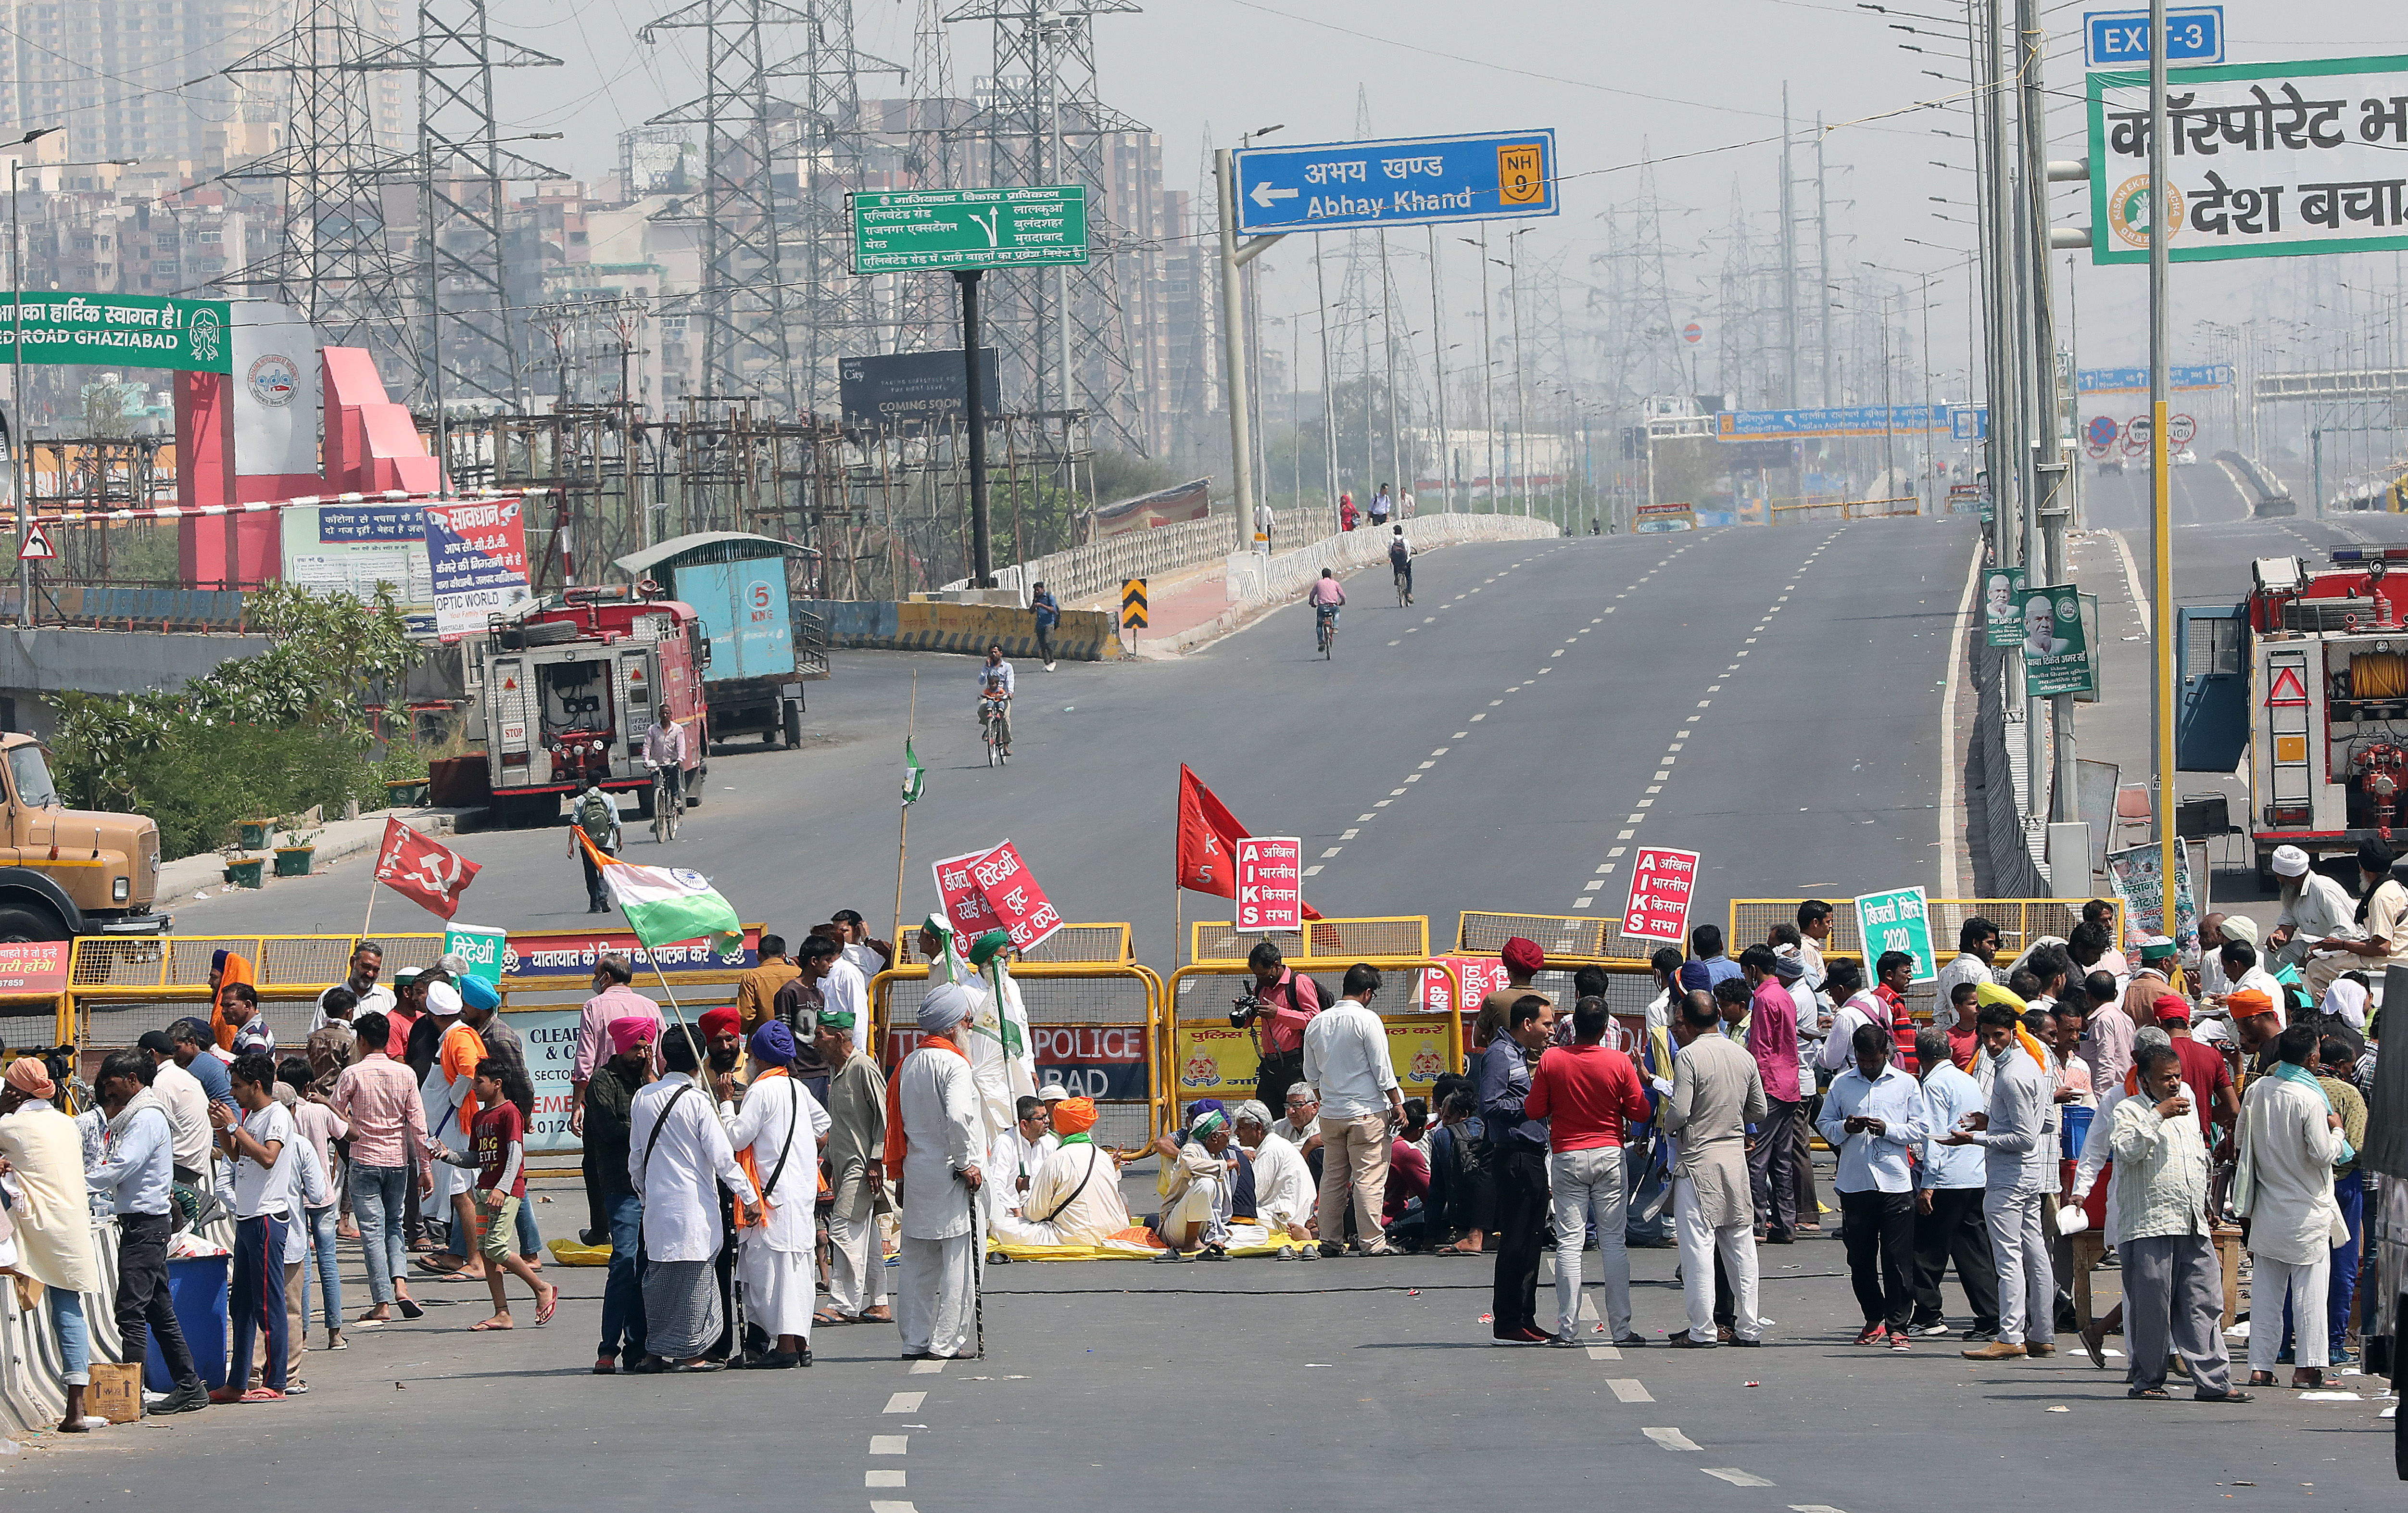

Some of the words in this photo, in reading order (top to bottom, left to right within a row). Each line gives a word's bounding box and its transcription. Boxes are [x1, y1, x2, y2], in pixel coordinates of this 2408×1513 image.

[1304, 160, 1367, 185] अभय
[1381, 155, 1443, 179] खण्ड
[1507, 155, 1532, 170] NH
[1515, 174, 1527, 194] 9
[962, 191, 1001, 202] विकास
[1007, 190, 1059, 201] प्राधिकरण
[1307, 195, 1384, 218] Abhay
[1394, 186, 1472, 213] Khand
[2113, 189, 2127, 220] KISAN
[2188, 169, 2284, 235] देश
[863, 208, 911, 223] एलिवेटेड
[913, 206, 932, 218] रोड
[1013, 216, 1064, 231] बुलंदशहर
[863, 223, 904, 236] राजनगर
[864, 239, 888, 250] मेरठ
[1014, 232, 1064, 246] मुरादाबाद
[910, 252, 927, 264] रोड
[929, 252, 938, 264] में
[943, 251, 962, 264] भारी
[998, 250, 1012, 261] का
[49, 296, 101, 323] हार्दिक
[104, 305, 158, 326] स्वागत
[22, 330, 70, 344] ROAD
[74, 330, 178, 350] GHAZIABAD
[844, 369, 865, 382] City
[878, 399, 927, 413] COMING
[929, 398, 962, 410] SOON
[448, 504, 500, 531] सावधान
[444, 543, 461, 555] आप
[457, 556, 470, 572] की
[470, 553, 504, 571] निगरानी
[436, 595, 463, 612] OPTIC
[464, 591, 500, 609] WORLD
[755, 586, 769, 607] 5
[2061, 654, 2077, 664] अमर
[504, 727, 523, 739] STOP
[1261, 843, 1297, 859] अखिल
[974, 849, 1021, 891] विदेशी
[1258, 863, 1297, 880] भारतीय
[1659, 855, 1693, 873] अखिल
[1241, 844, 1260, 924] AIKS
[1261, 884, 1297, 902] किसान
[1628, 853, 1657, 932] AIKS
[1652, 876, 1690, 894] भारतीय
[2115, 880, 2155, 896] किसान
[956, 893, 981, 920] रसोई
[1002, 885, 1029, 916] लूट
[1650, 894, 1687, 915] किसान
[2131, 896, 2150, 908] गेट
[1264, 909, 1293, 922] सभा
[1864, 897, 1898, 927] बिजली
[1898, 895, 1921, 921] बिल
[1009, 921, 1034, 945] बंद
[1029, 901, 1060, 929] करो
[1650, 918, 1678, 934] सभा
[956, 929, 969, 953] के
[1883, 927, 1911, 952] 2020
[30, 946, 40, 958] तो
[451, 934, 495, 964] विदेशी
[531, 949, 580, 968] यातायात
[581, 942, 596, 967] के
[654, 946, 688, 964] पालन
[689, 938, 711, 963] करें
[1462, 964, 1489, 1008] कानून
[1429, 985, 1449, 1010] MSP
[1190, 1029, 1243, 1043] पुलिस
[1412, 1024, 1446, 1035] करें
[1035, 1028, 1142, 1059] POLICE
[545, 1046, 558, 1060] &
